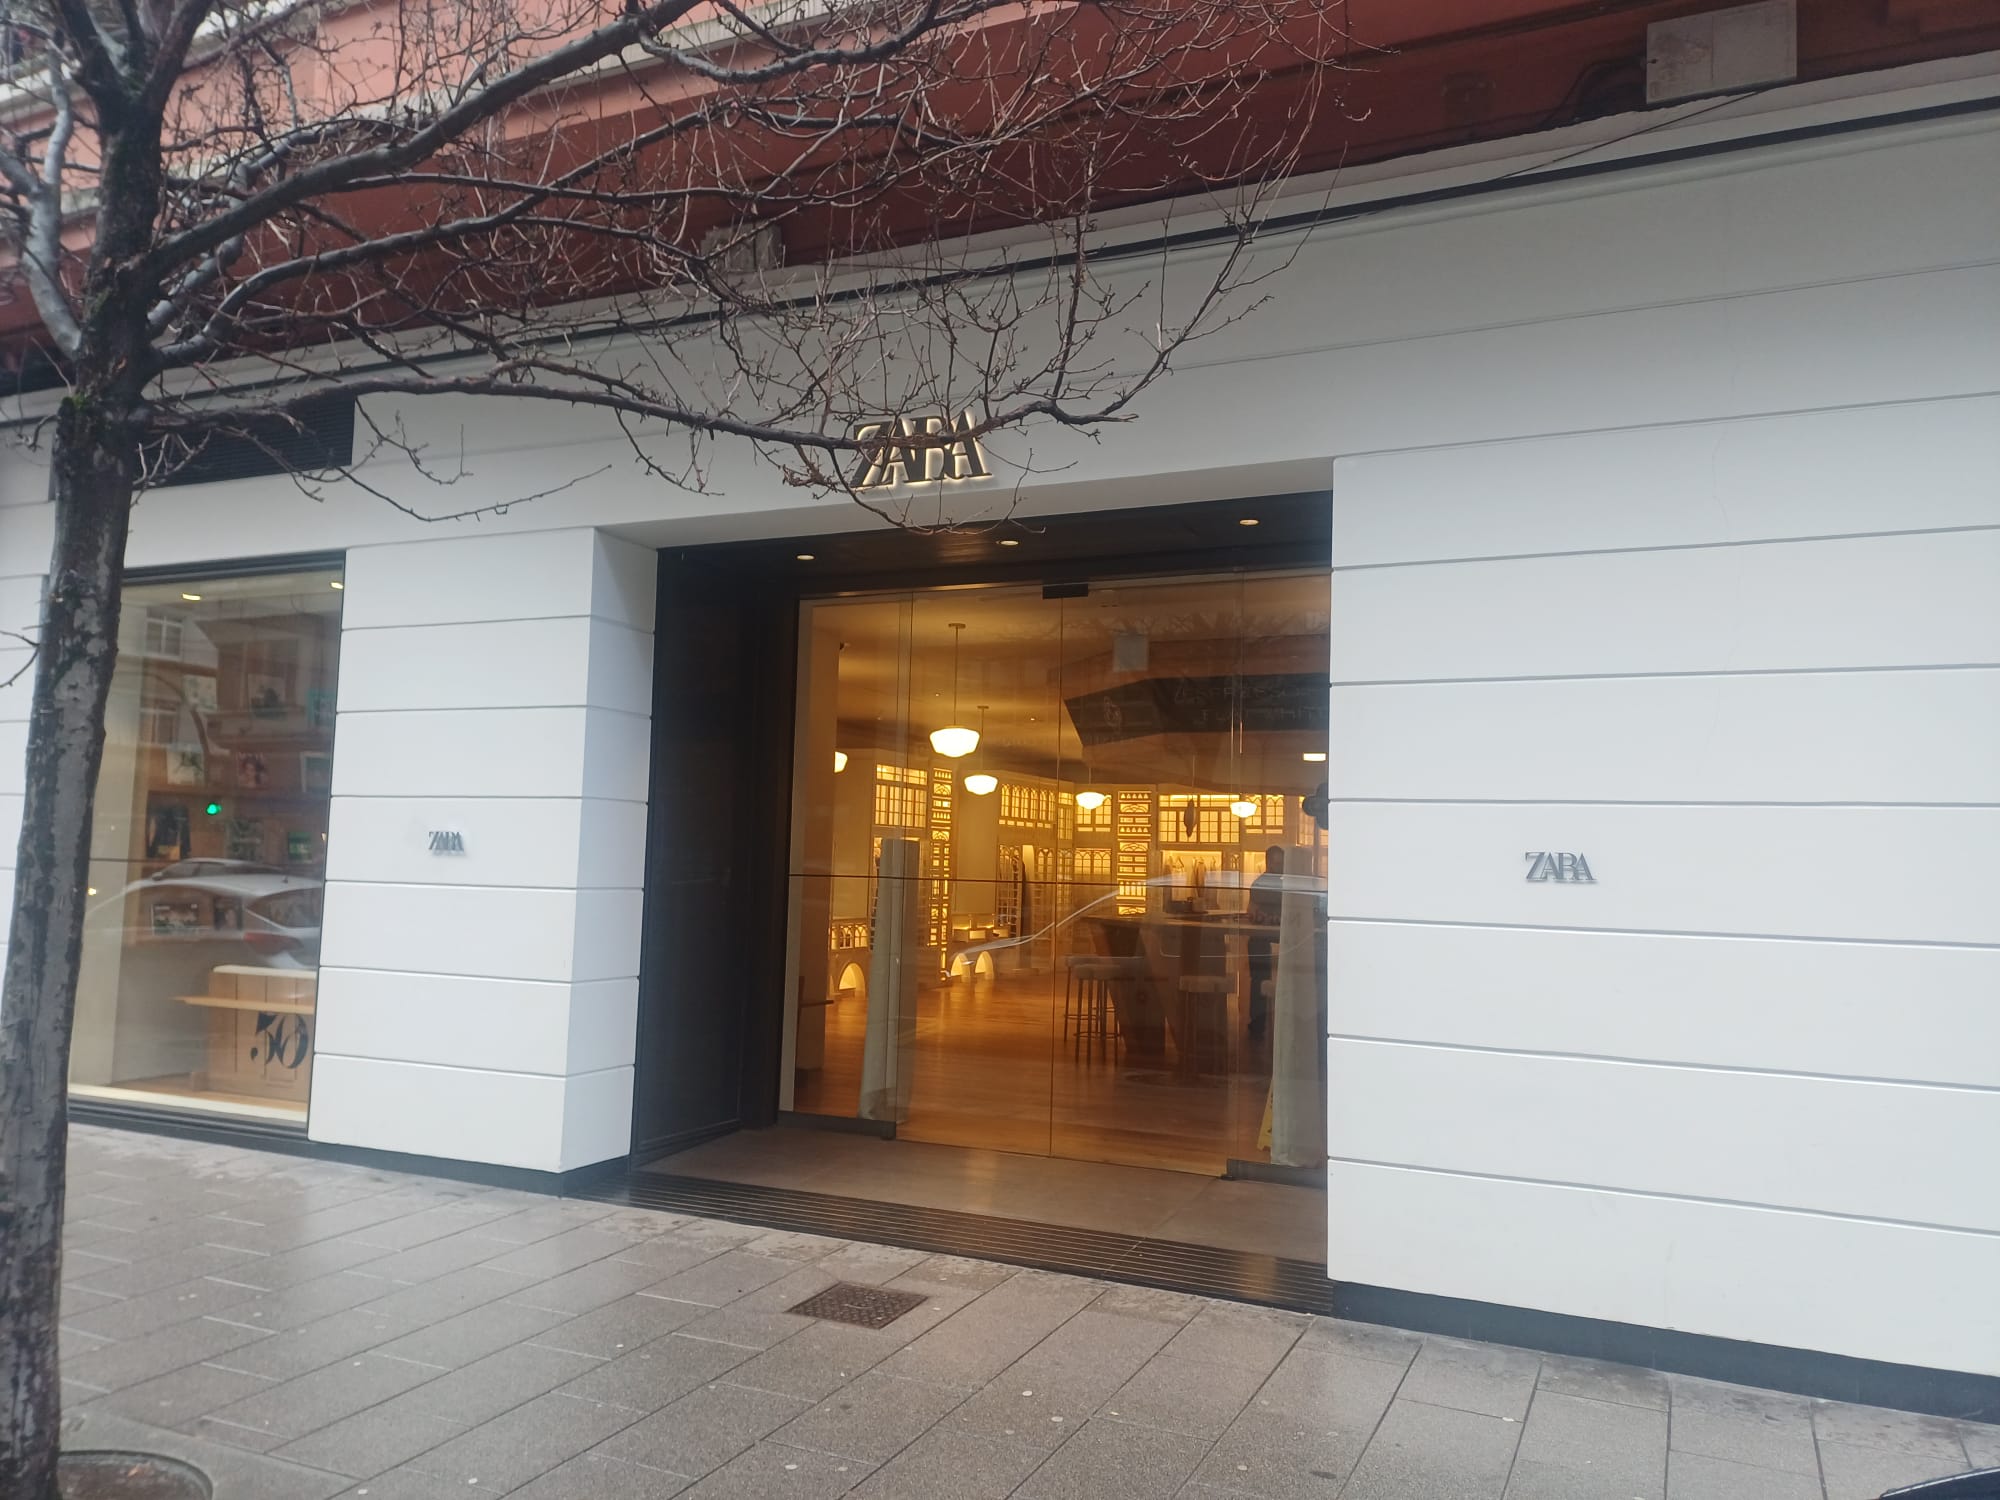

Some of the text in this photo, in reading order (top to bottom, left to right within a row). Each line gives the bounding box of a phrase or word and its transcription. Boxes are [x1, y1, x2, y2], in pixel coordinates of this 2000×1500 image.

[851, 411, 993, 488] ZARA
[428, 831, 465, 854] ZARA
[1525, 851, 1597, 883] ZARA
[250, 1011, 309, 1069] 50
